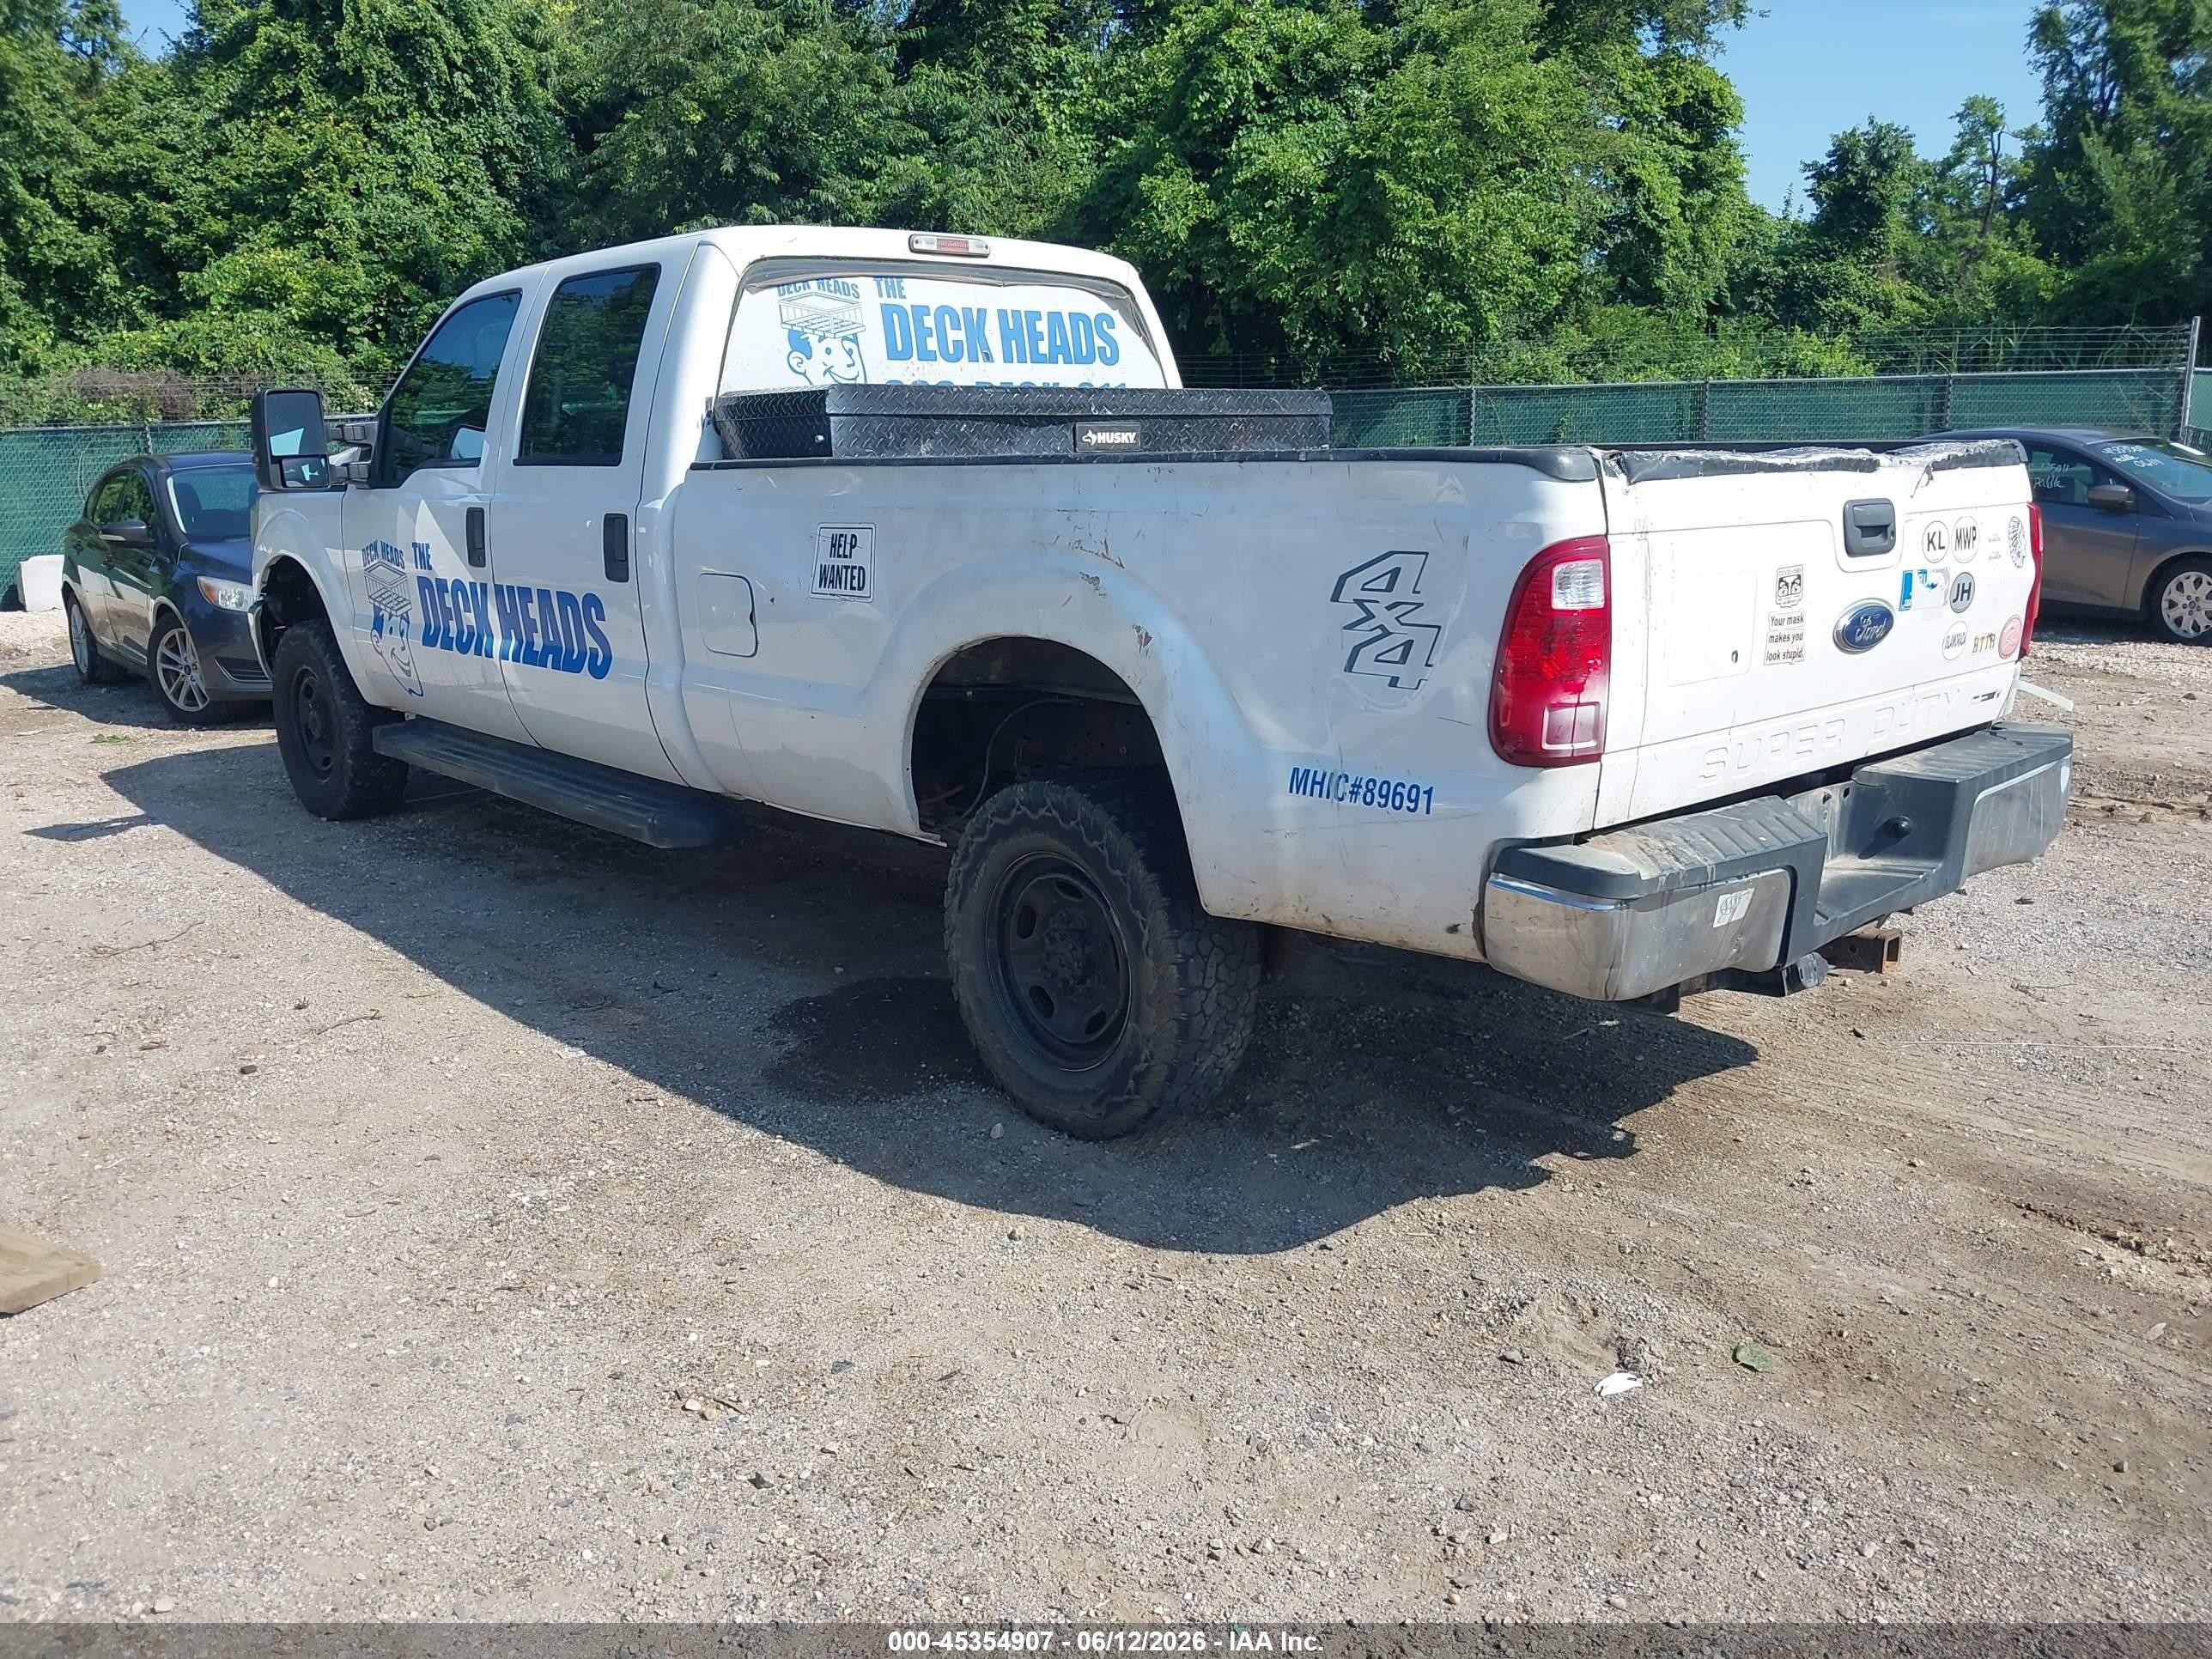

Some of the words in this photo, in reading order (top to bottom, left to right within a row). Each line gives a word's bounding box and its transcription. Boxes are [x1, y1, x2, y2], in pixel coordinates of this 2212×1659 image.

[817, 277, 860, 299] HEADS
[873, 276, 907, 299] THE
[880, 303, 993, 363] DECK
[996, 309, 1120, 366] HEADS
[1097, 432, 1137, 444] HUSKY
[830, 533, 857, 559] HELP
[1927, 531, 1946, 551] KL
[1954, 526, 1977, 551] MWP
[362, 540, 379, 568] DECK
[380, 540, 405, 569] HEADS
[412, 542, 432, 570] THE
[818, 563, 866, 591] WANTED
[1952, 582, 1972, 603] JH
[416, 576, 495, 659] DECK
[494, 583, 613, 680] HEADS
[1771, 615, 1785, 627] Your
[1787, 612, 1804, 625] mask
[1855, 614, 1887, 642] Ford
[1768, 632, 1790, 644] makes
[1792, 632, 1803, 644] you
[1766, 650, 1780, 661] look
[1696, 718, 1847, 789] SUPER
[1867, 689, 1961, 744] DUTY
[1288, 767, 1434, 815] MHIC#89691
